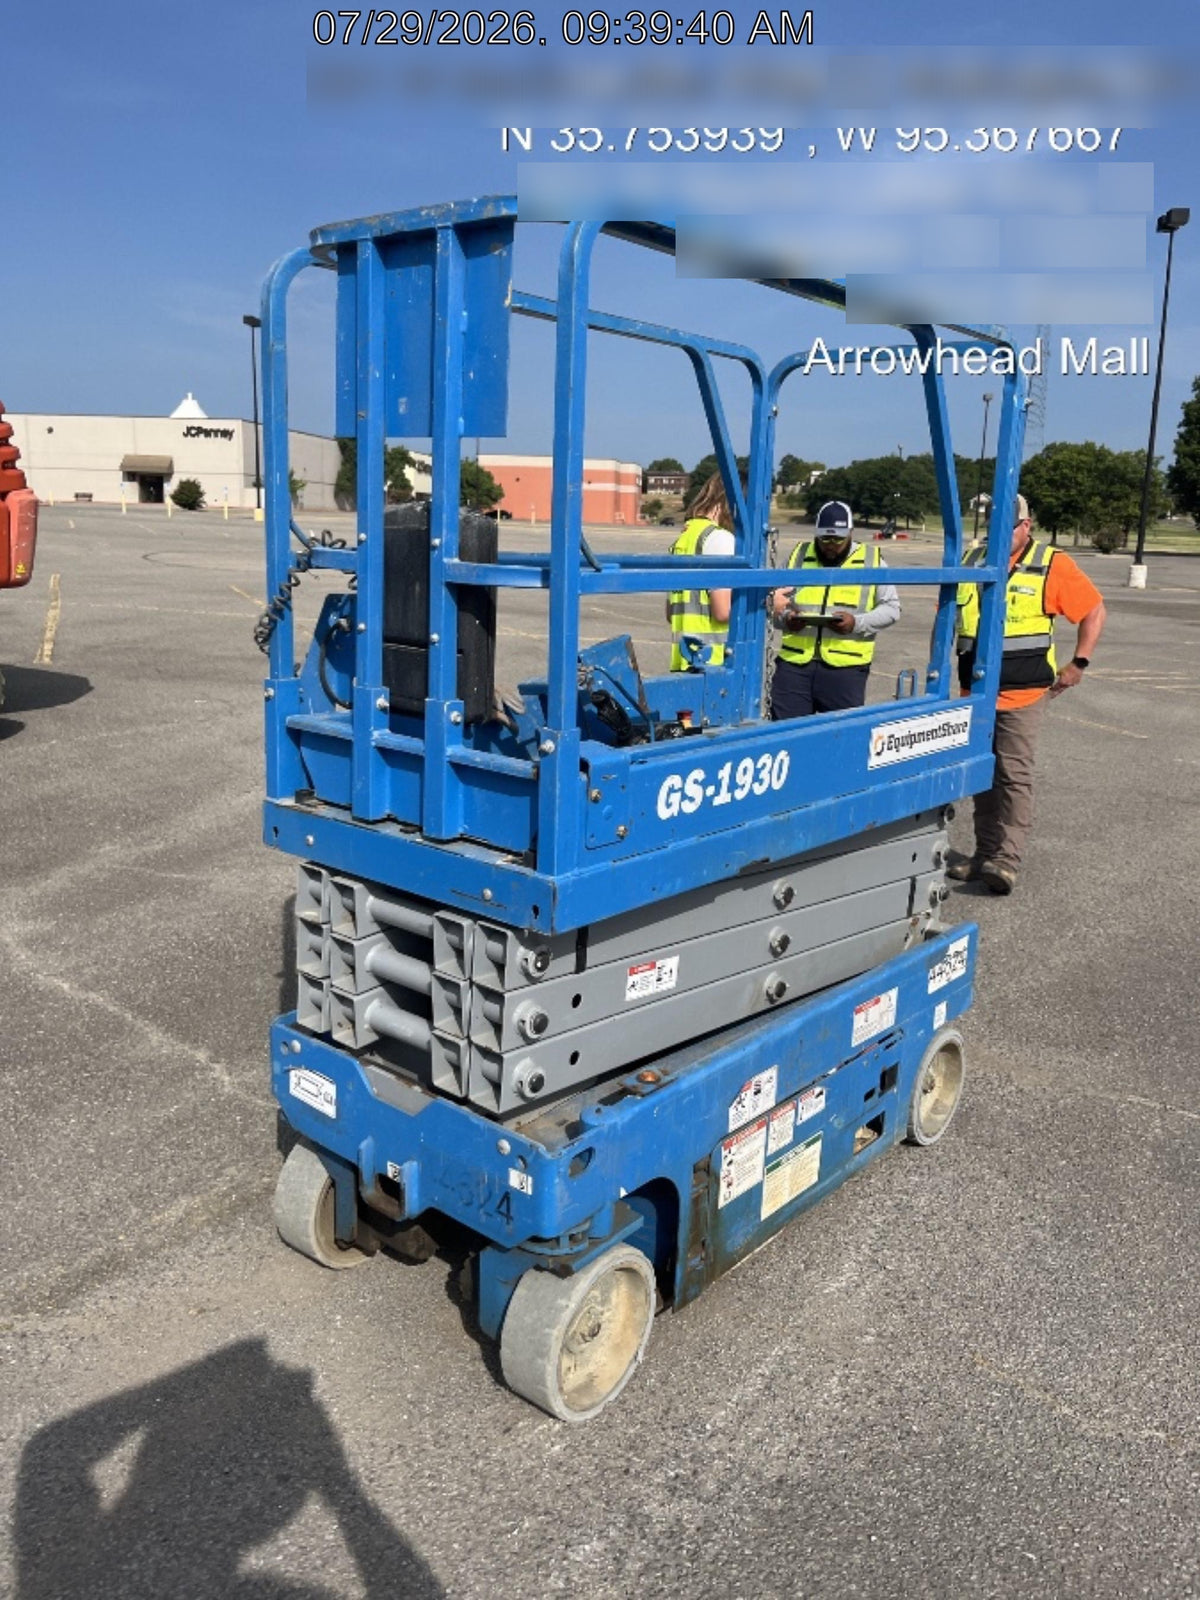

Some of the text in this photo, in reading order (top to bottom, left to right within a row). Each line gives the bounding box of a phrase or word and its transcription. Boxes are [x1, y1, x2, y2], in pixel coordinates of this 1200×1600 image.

[182, 425, 235, 441] JCPenney
[886, 721, 968, 753] EquipmentShare
[657, 749, 790, 820] GS-1930
